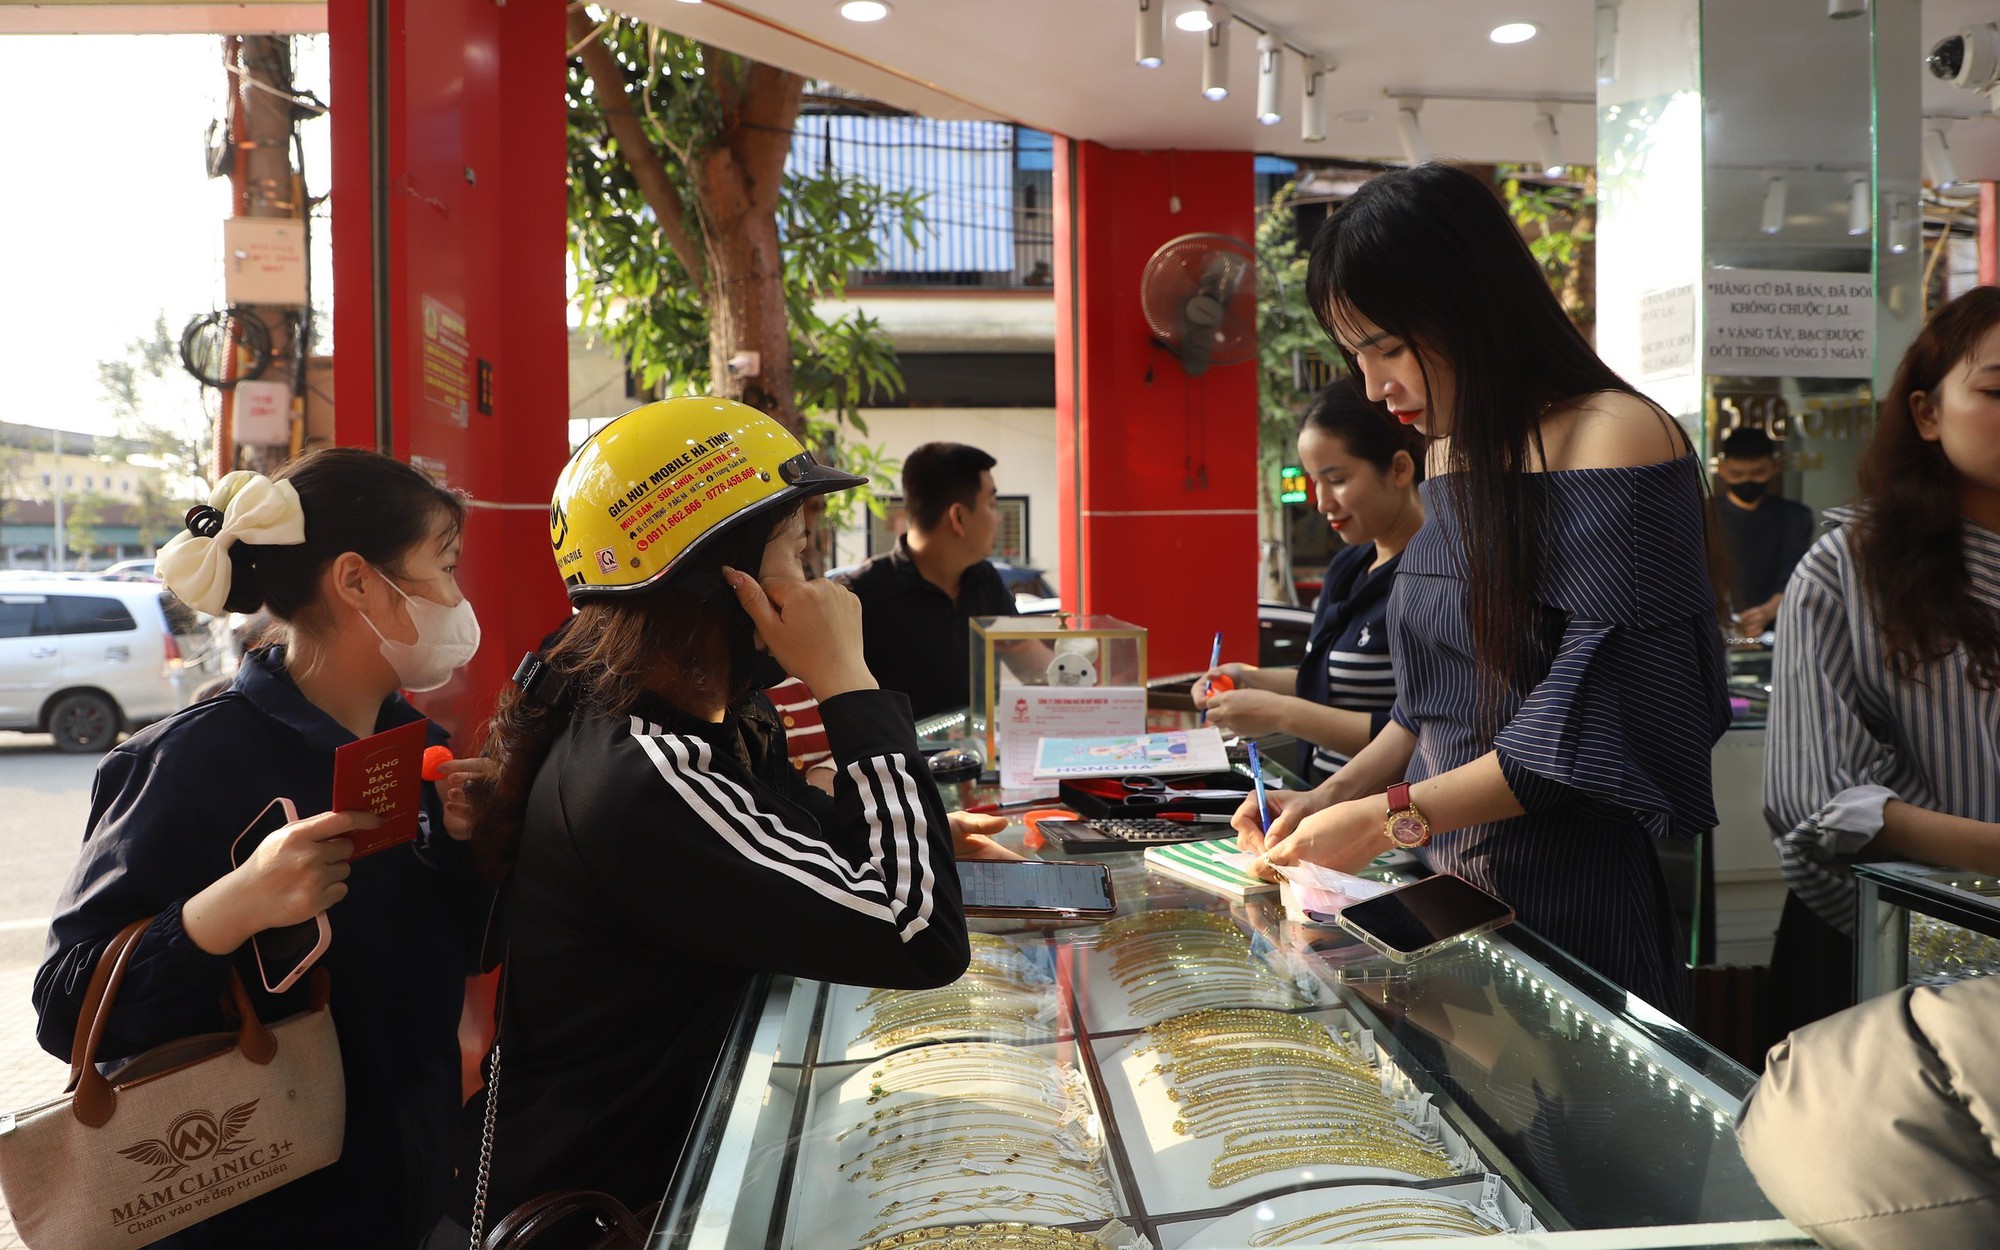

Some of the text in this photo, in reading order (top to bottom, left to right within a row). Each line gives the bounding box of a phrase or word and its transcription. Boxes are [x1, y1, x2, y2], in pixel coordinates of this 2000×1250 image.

[1754, 282, 1773, 296] CŨ
[1774, 282, 1793, 296] ĐÃ
[1829, 284, 1848, 298] ĐÃ
[1779, 301, 1825, 317] CHUỘC
[1727, 325, 1764, 340] VÀNG
[1798, 329, 1826, 343] BẠC
[1826, 329, 1865, 343] ĐƯỢC
[1736, 345, 1780, 358] TRONG
[1783, 345, 1820, 359] VÒNG
[608, 498, 629, 518] GIA
[626, 481, 650, 503] HUY
[649, 453, 693, 486] MOBILE
[690, 443, 709, 459] HÀ
[646, 466, 757, 544] 0911.662.666 0776.456.666
[620, 515, 638, 532] MUA
[365, 758, 399, 774] VÀNG
[369, 771, 393, 785] BẠC
[362, 780, 398, 798] NGỌC
[371, 792, 388, 805] HÀ
[110, 1139, 294, 1225] MẬM CLINIC 3+
[127, 1212, 166, 1235] Chạm
[169, 1202, 193, 1218] vào
[212, 1183, 235, 1203] đẹp
[253, 1161, 288, 1183] nhiên
